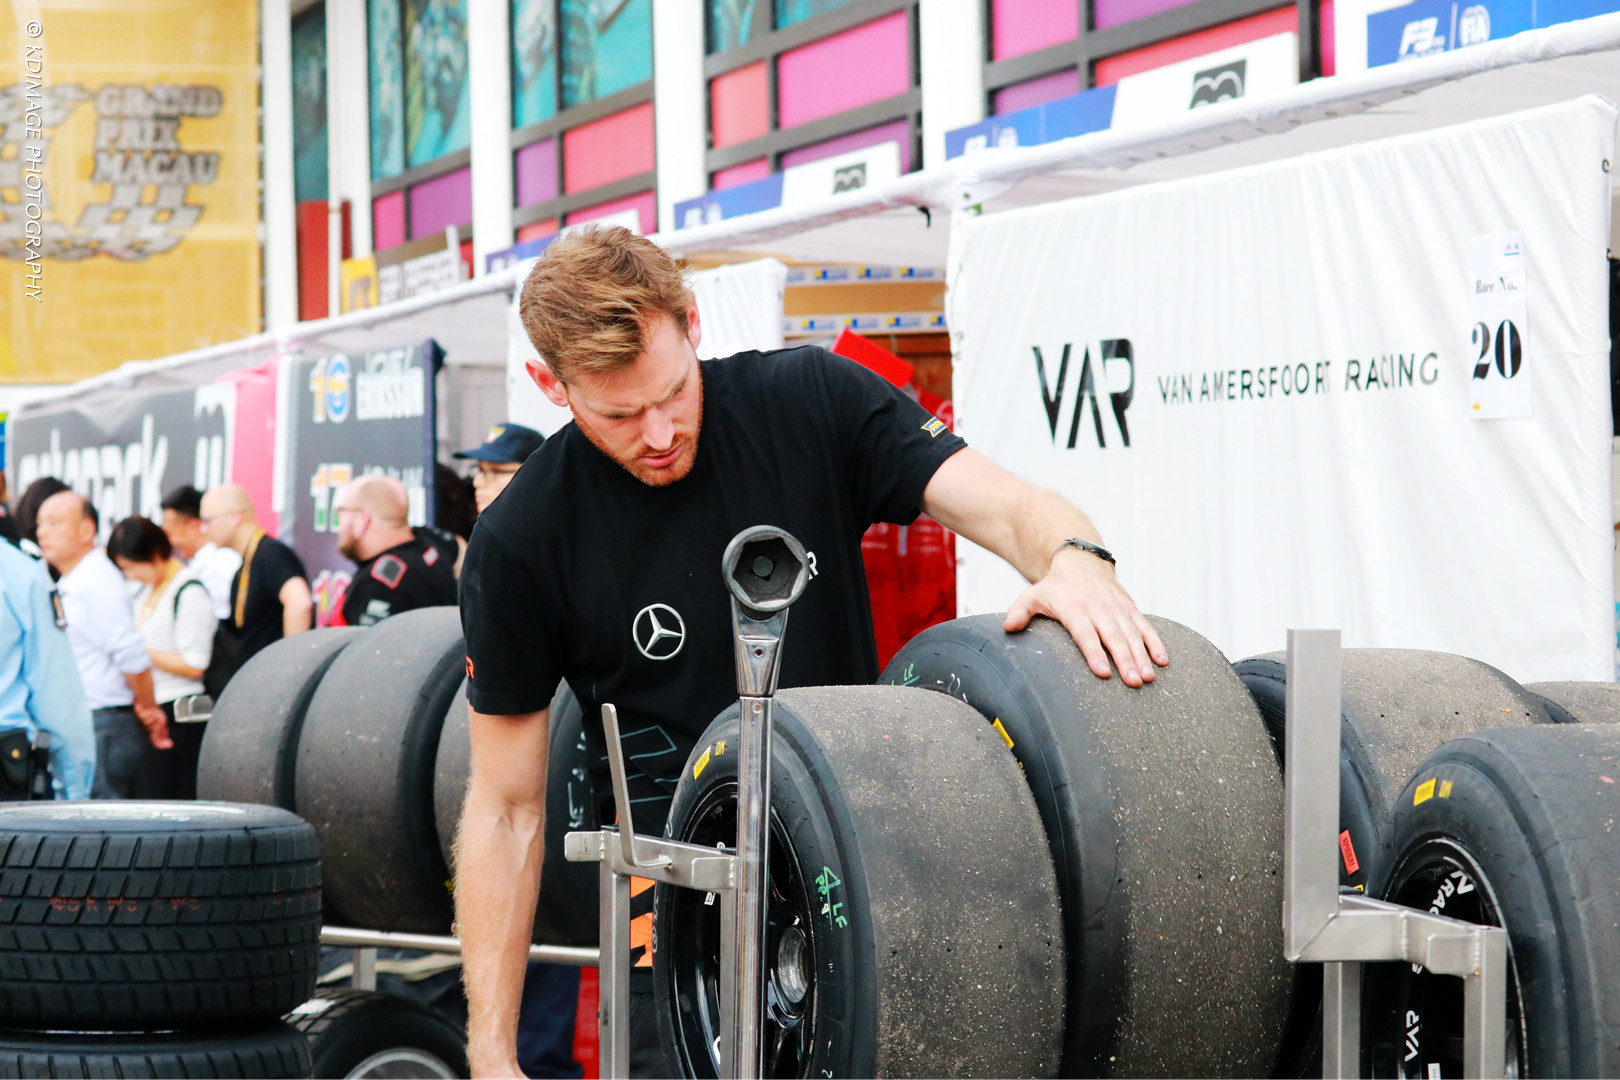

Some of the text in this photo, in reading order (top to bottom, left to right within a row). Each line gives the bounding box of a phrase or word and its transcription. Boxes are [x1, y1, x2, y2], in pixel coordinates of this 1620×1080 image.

[94, 117, 180, 150] PRIX
[92, 150, 220, 184] MACAU
[1472, 318, 1523, 381] 20
[1031, 338, 1440, 449] VAR VAN AMERSFOORT RACING
[1404, 1009, 1420, 1062] VAR
